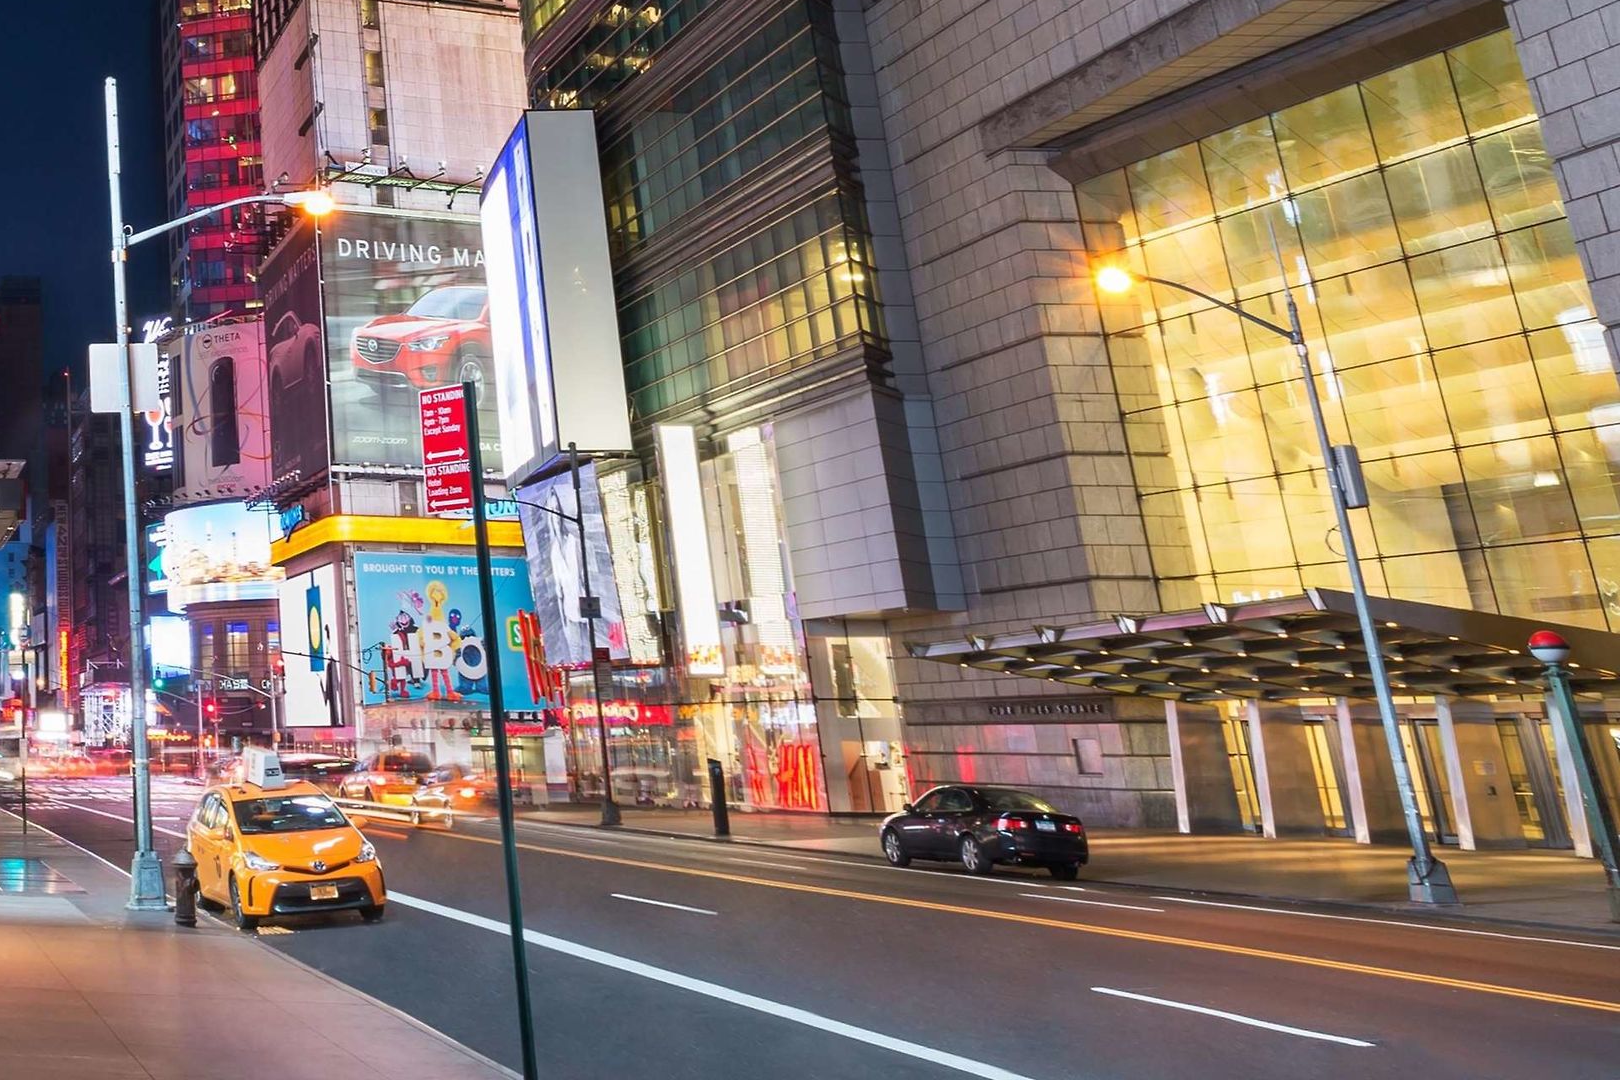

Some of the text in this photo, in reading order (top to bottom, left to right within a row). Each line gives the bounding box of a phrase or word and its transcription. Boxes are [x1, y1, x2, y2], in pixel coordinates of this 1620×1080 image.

[337, 238, 442, 265] DRIVING
[214, 332, 241, 344] THETA
[422, 395, 431, 404] NO
[424, 424, 461, 436] Except Sunday
[352, 435, 408, 445] zoom-zoom
[427, 467, 437, 476] NO
[427, 478, 442, 487] Hotel
[428, 486, 462, 497] Loading Zone
[363, 563, 407, 573] BROUGHT
[411, 565, 423, 574] TO
[425, 565, 445, 575] YOU
[447, 566, 458, 575] BY
[461, 566, 479, 576] THE
[391, 621, 489, 680] HBO
[1055, 704, 1104, 714] SQUARE
